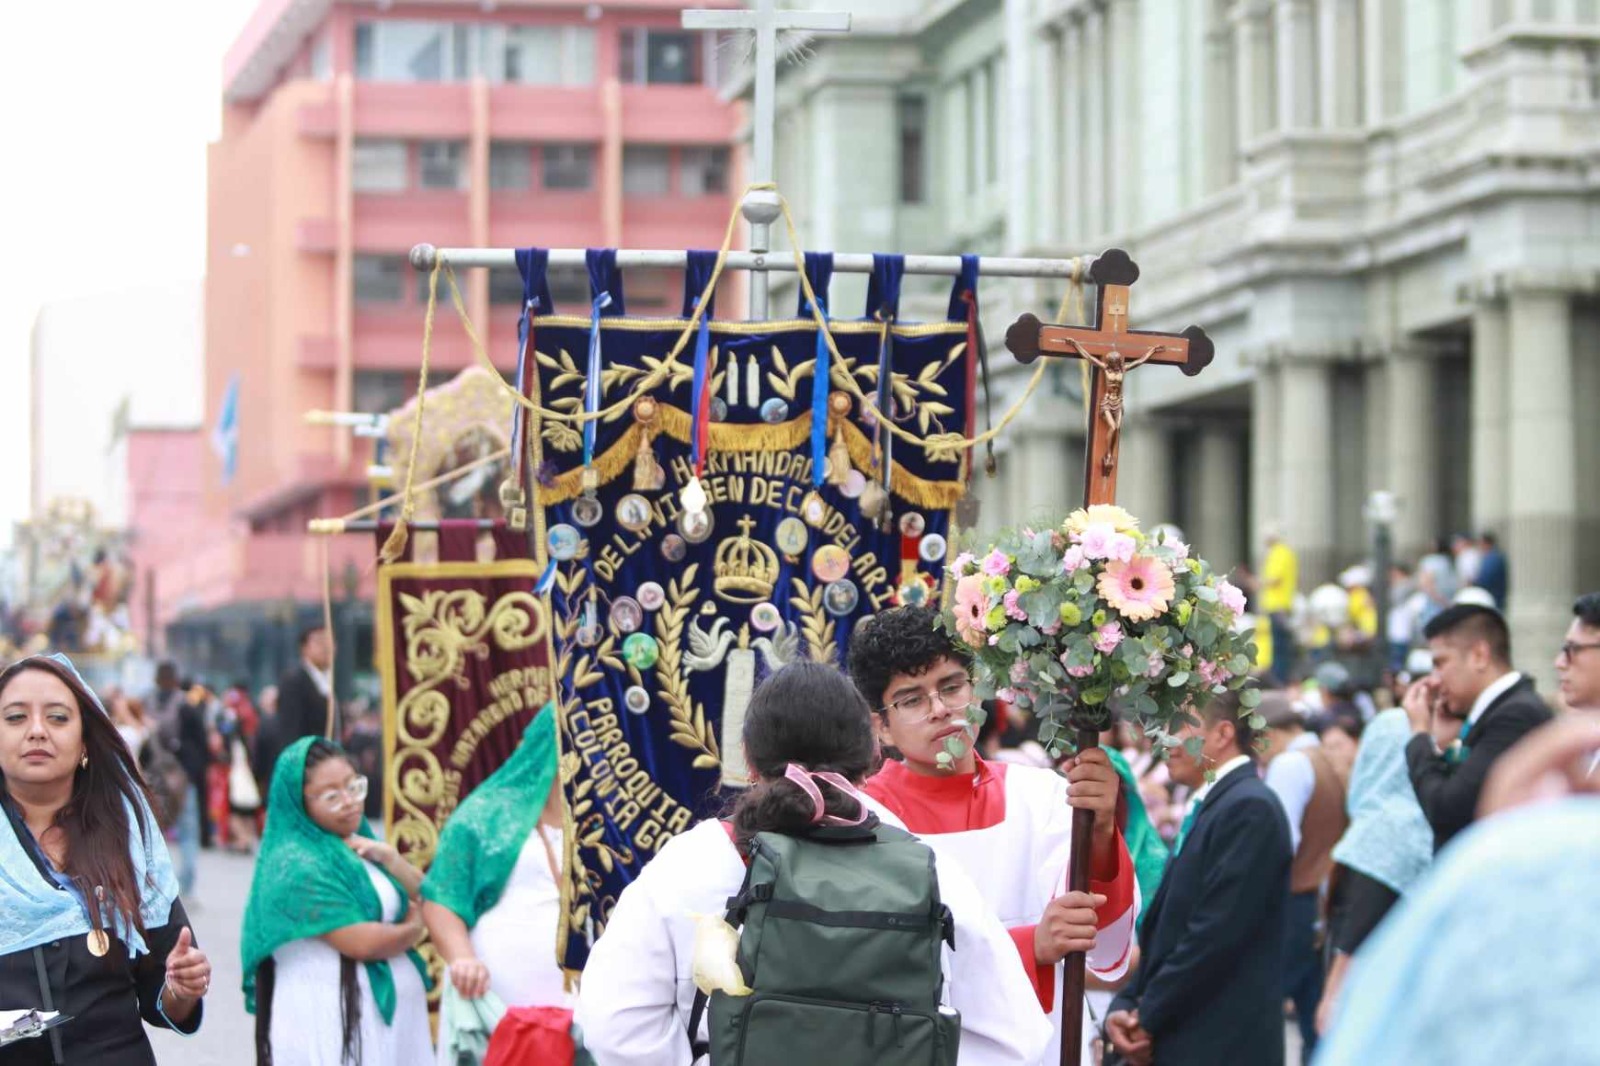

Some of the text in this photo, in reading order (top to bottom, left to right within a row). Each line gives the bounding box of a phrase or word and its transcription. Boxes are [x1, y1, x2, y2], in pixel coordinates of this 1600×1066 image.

[671, 450, 813, 484] HRMANDA
[593, 544, 625, 582] DE
[651, 475, 744, 528] VIGEN
[750, 477, 784, 509] DE
[786, 486, 902, 613] CDELARI
[569, 710, 641, 831] COLONIA
[586, 697, 693, 834] PARROQUIA
